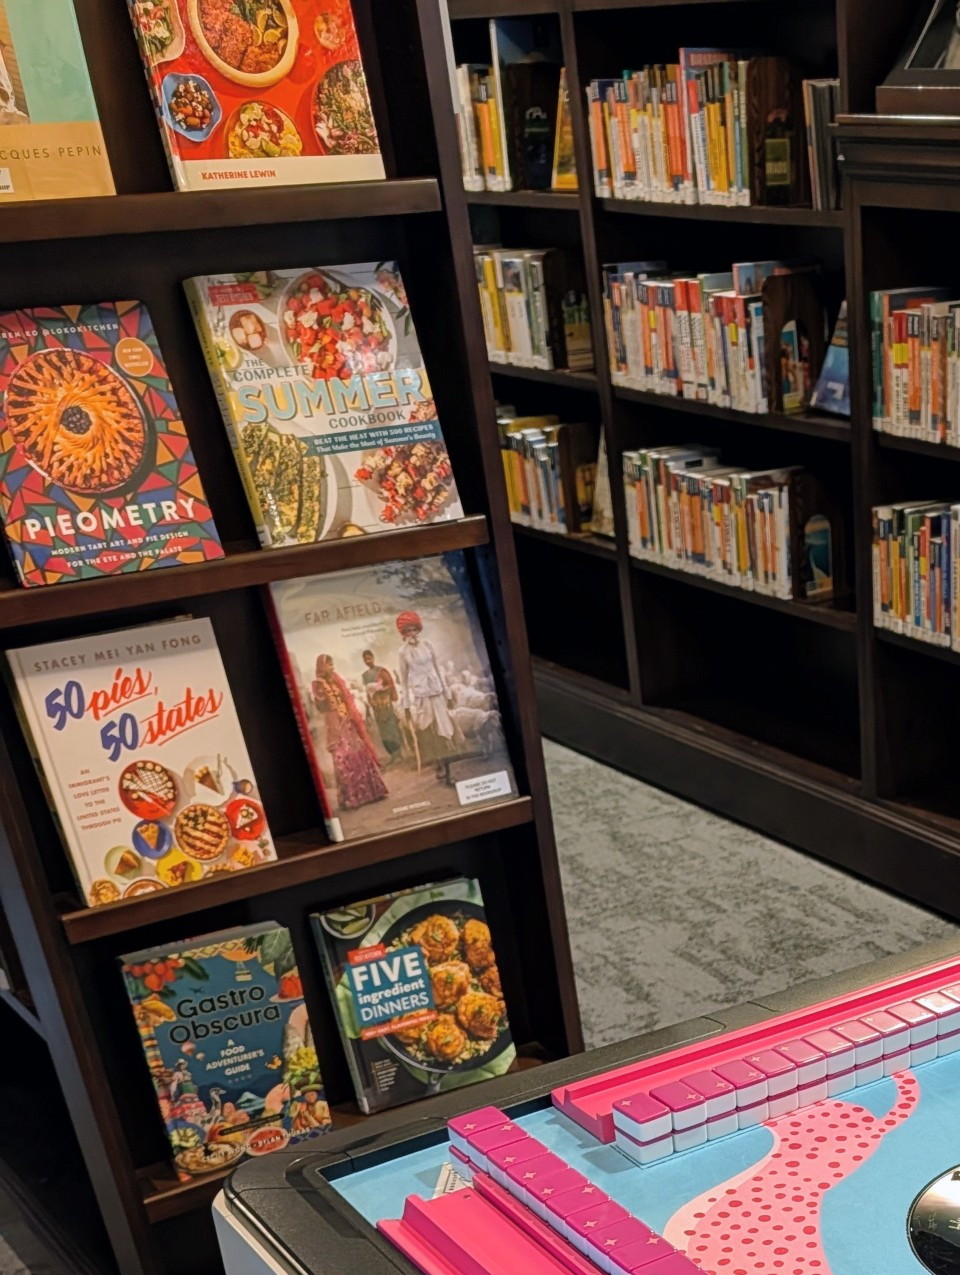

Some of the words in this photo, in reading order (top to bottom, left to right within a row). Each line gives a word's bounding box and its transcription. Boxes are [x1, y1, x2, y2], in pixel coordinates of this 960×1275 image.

[58, 145, 102, 158] PEPIN
[201, 171, 249, 180] KATHERINE
[249, 170, 276, 179] LEWIN
[0, 331, 21, 339] REN
[233, 364, 311, 383] COMPLETE
[244, 358, 265, 368] THE
[238, 367, 429, 424] SUMMER
[328, 410, 407, 429] COOKBOOK
[314, 437, 332, 446] BEAT
[333, 435, 349, 444] THE
[349, 433, 368, 442] HEAT
[368, 430, 389, 439] WITH
[403, 424, 434, 434] RECIPES
[349, 441, 360, 449] the
[376, 439, 383, 447] of
[24, 497, 196, 540] PIEOMETRY
[51, 545, 87, 556] MODERN
[88, 542, 108, 552] TART
[110, 539, 125, 549] ART
[127, 536, 145, 546] AND
[146, 534, 159, 543] PIE
[159, 530, 189, 541] DESIGN
[67, 560, 84, 569] FOR
[86, 557, 102, 566] THE
[103, 555, 118, 564] EYE
[119, 552, 137, 561] AND
[138, 549, 154, 558] THE
[155, 546, 183, 556] PALATE
[304, 610, 330, 625] FAR
[336, 602, 382, 621] AFIELD
[34, 654, 87, 672] STACEY
[93, 647, 121, 663] MEI
[125, 642, 156, 656] YAN
[161, 634, 202, 650] FONG
[45, 680, 86, 731] 50
[85, 667, 159, 721] pies,
[100, 713, 139, 763] 50
[138, 687, 224, 748] states
[351, 951, 422, 992] FIVE
[176, 986, 265, 1019] Gastro
[357, 978, 426, 1005] ingredient
[360, 991, 430, 1022] DINNERS
[169, 1004, 281, 1044] Obscura
[220, 1045, 246, 1058] FOOD
[227, 1038, 236, 1047] A
[206, 1049, 266, 1071] ADVENTURER'S
[224, 1063, 251, 1076] GUIDE
